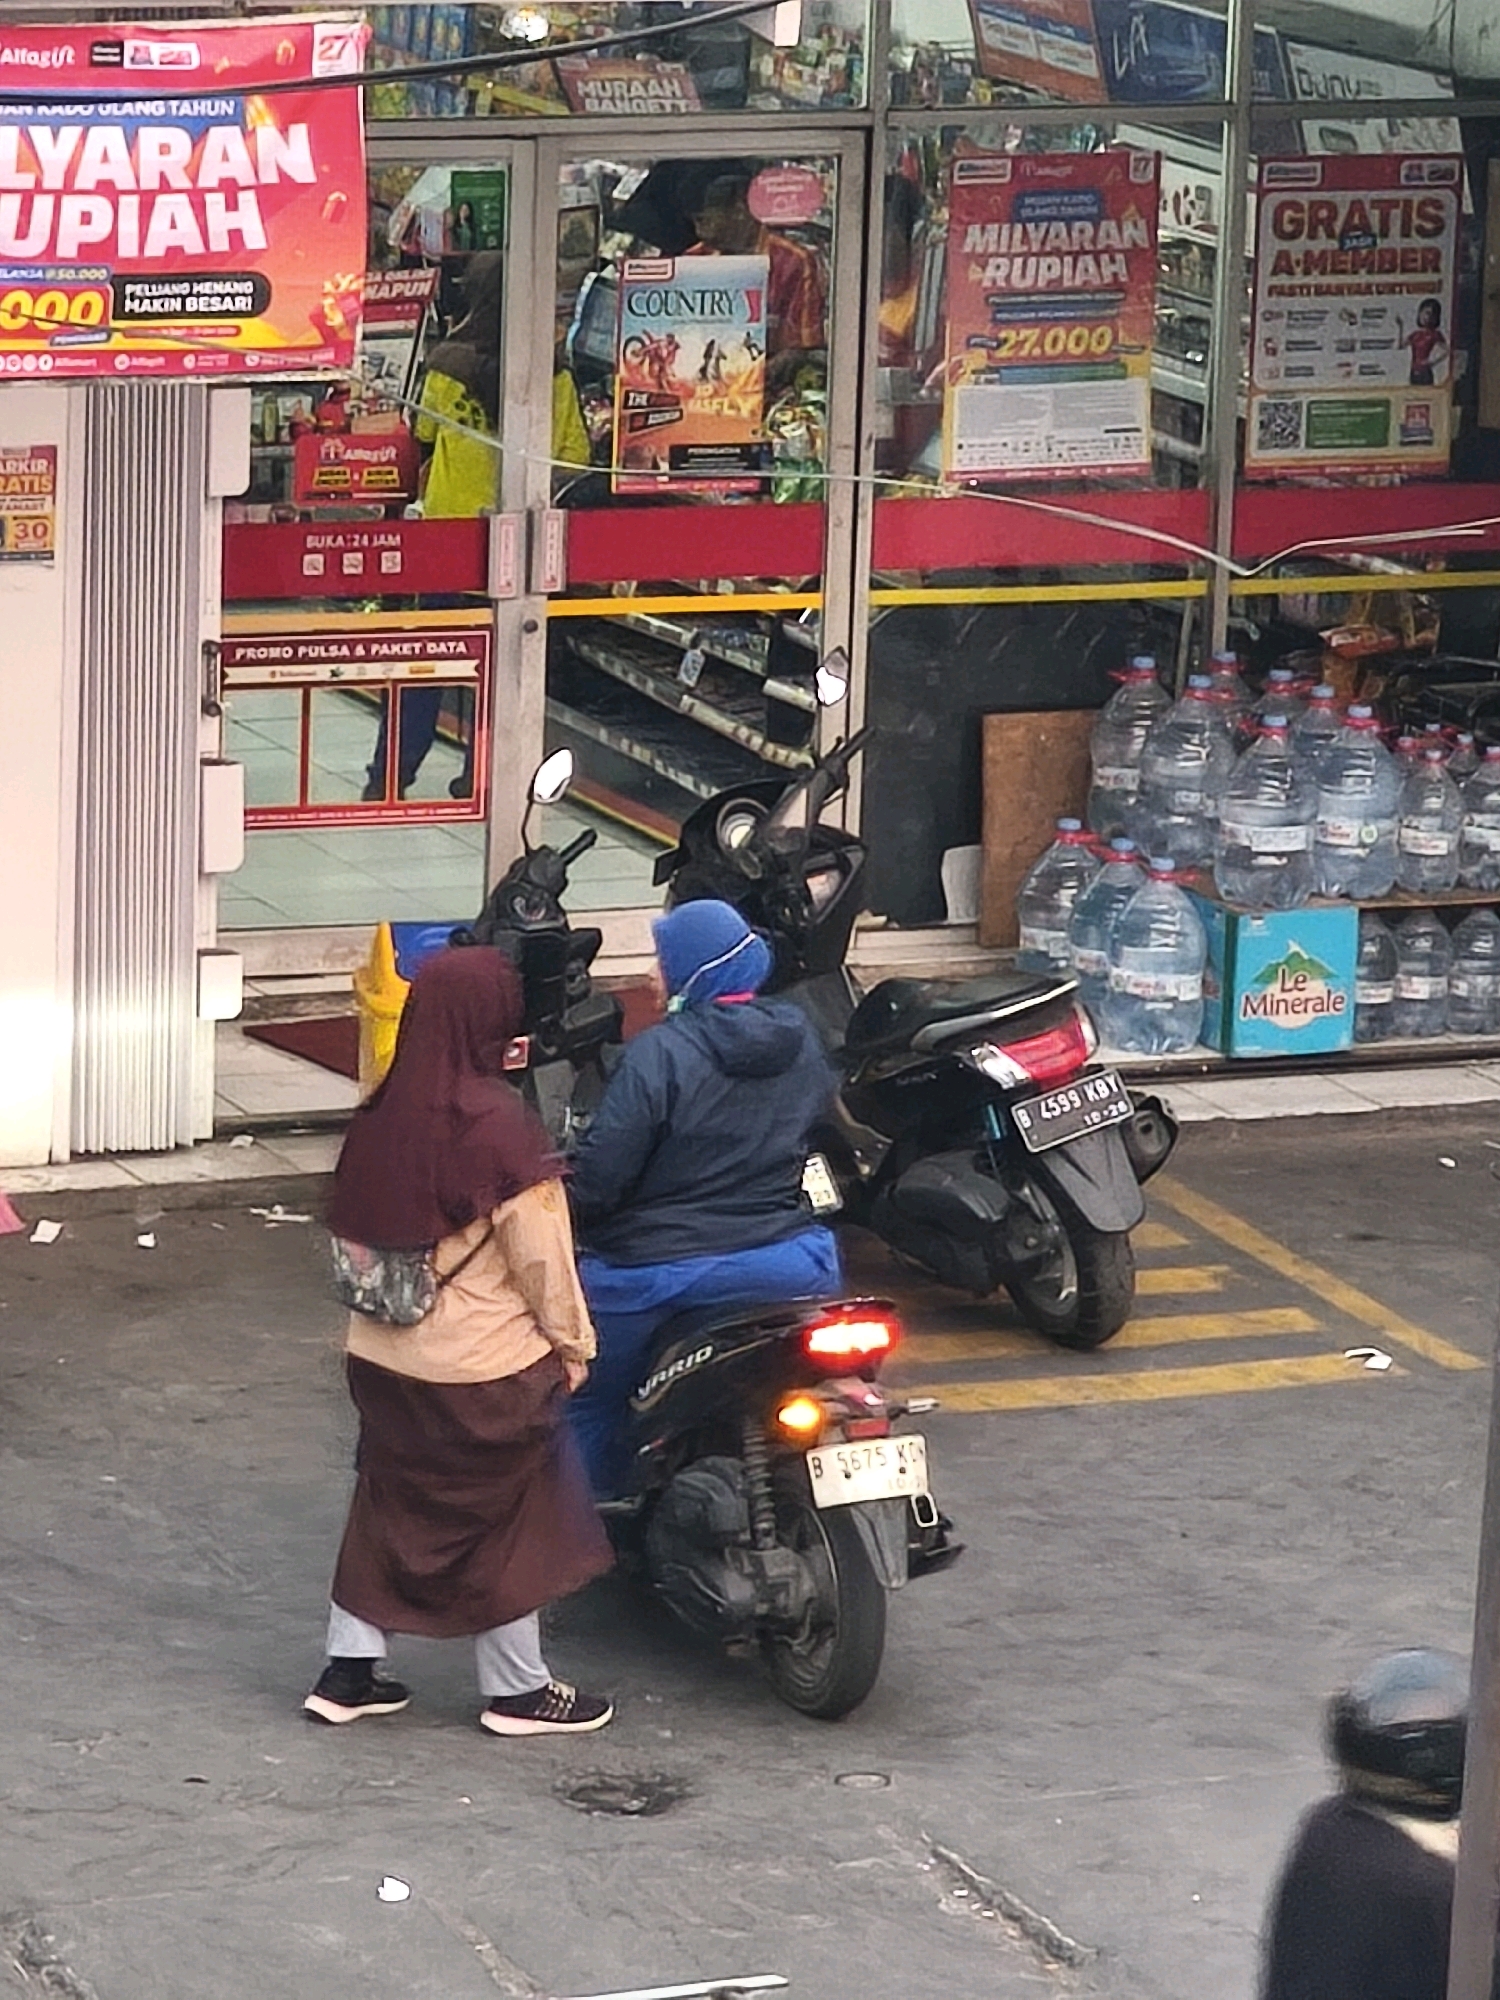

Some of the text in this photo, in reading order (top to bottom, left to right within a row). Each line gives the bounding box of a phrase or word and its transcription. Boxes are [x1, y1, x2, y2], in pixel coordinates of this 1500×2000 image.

[98, 101, 166, 117] ULANG
[169, 100, 235, 116] TAHUN
[0, 123, 317, 190] LYARAN
[0, 190, 268, 259] UPIAH
[1273, 199, 1446, 241] GRATIS
[964, 219, 1150, 254] MILYARAN
[981, 252, 1129, 288] RUPIAH
[125, 281, 254, 297] PELUANG MENANG
[627, 288, 740, 317] COUNTRY
[125, 295, 252, 313] MAKIN BESAR!
[994, 326, 1113, 358] 27.000
[14, 522, 48, 540] 30
[306, 534, 345, 549] BUKA
[372, 533, 401, 548] JAM
[235, 646, 293, 661] PROMO
[298, 644, 350, 659] PULSA
[371, 642, 423, 657] PAKET
[426, 640, 468, 655] DATA
[1280, 967, 1308, 993] Le
[1242, 989, 1345, 1018] Minerale
[1017, 1108, 1032, 1129] B
[1040, 1089, 1082, 1120] 4599
[811, 1456, 824, 1479] B
[837, 1446, 887, 1474] 5675
